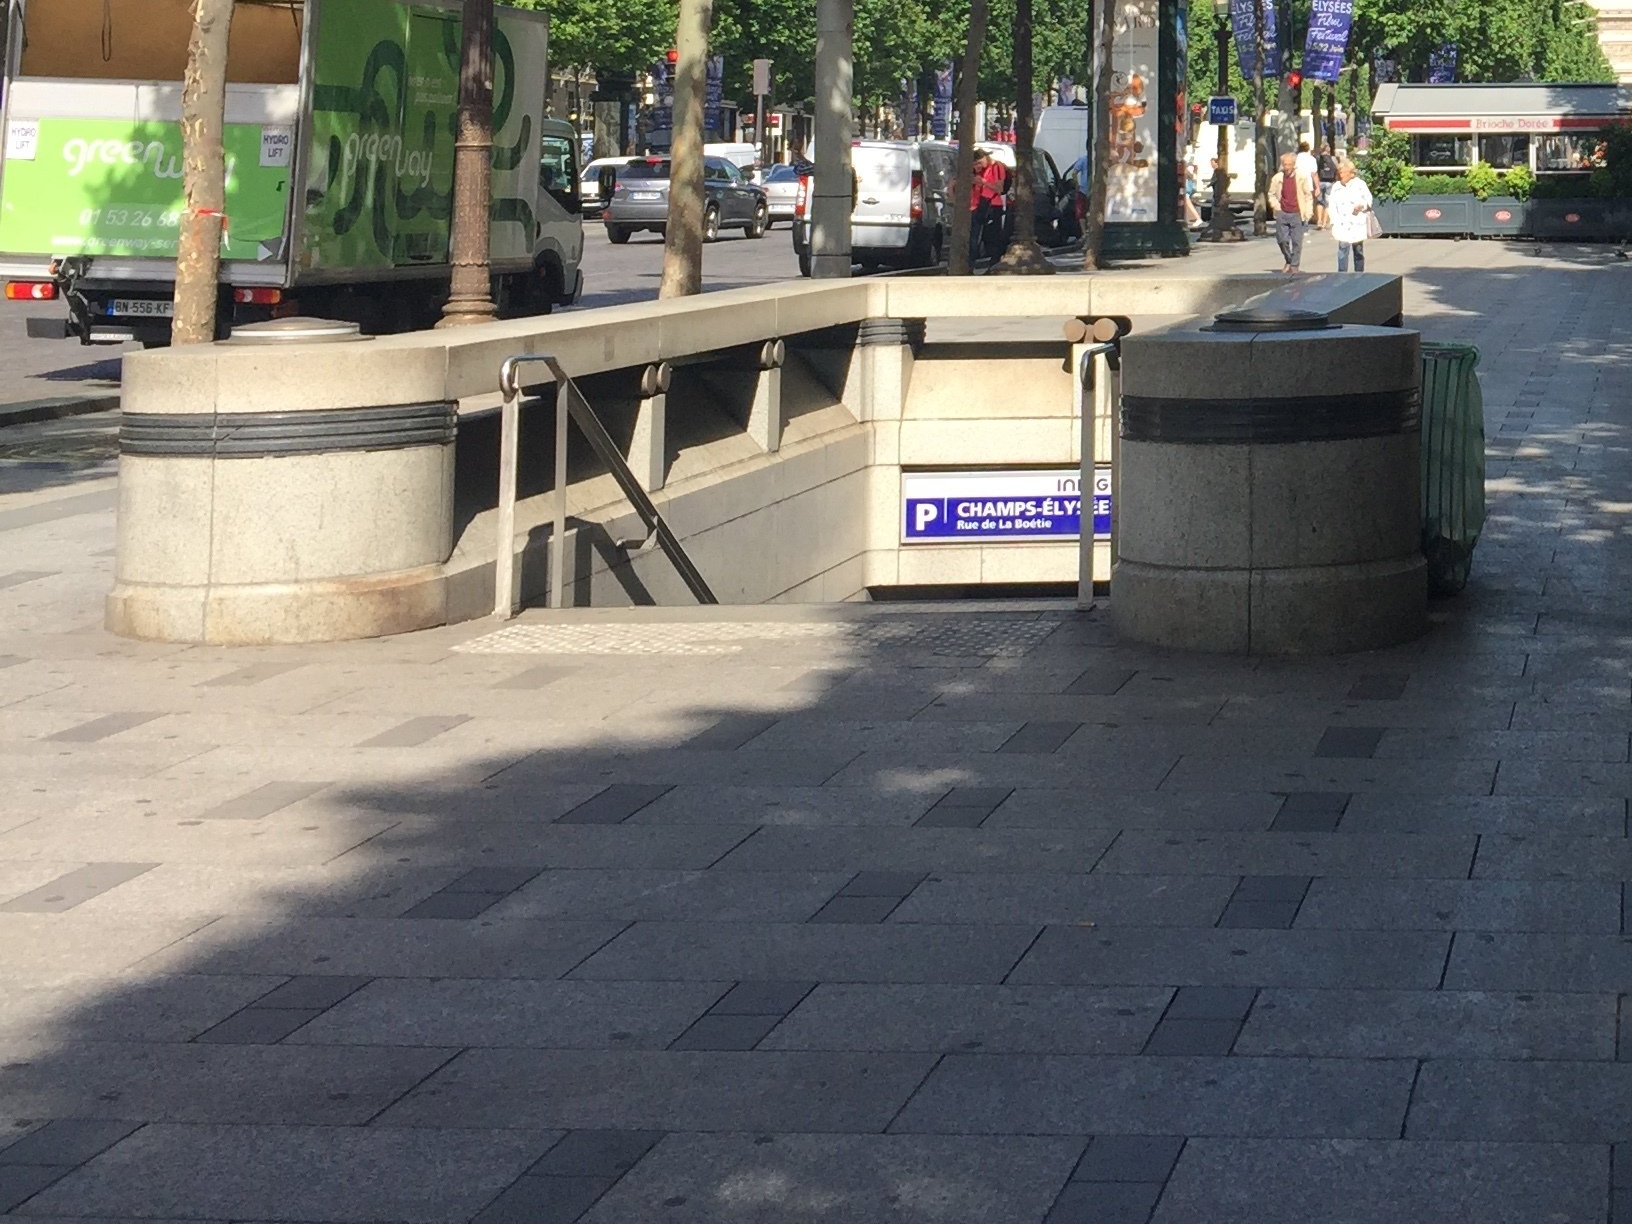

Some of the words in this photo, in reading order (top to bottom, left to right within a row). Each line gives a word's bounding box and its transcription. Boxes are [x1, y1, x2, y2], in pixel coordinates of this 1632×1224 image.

[1313, 0, 1352, 14] ÉLYSÉES
[1317, 13, 1343, 27] Film
[1212, 106, 1234, 114] TAXIS
[1476, 119, 1514, 128] Brioche
[1518, 118, 1548, 128] Dorée
[263, 134, 289, 146] HYDRO
[268, 147, 283, 158] LIFT
[106, 210, 129, 225] 53
[131, 210, 152, 226] 26
[957, 497, 1111, 517] CHAMPS-ÉLYSÉE
[915, 503, 938, 531] P
[957, 520, 979, 530] Rue
[981, 519, 996, 529] de
[999, 519, 1012, 529] La
[1015, 518, 1052, 529] Boétie
